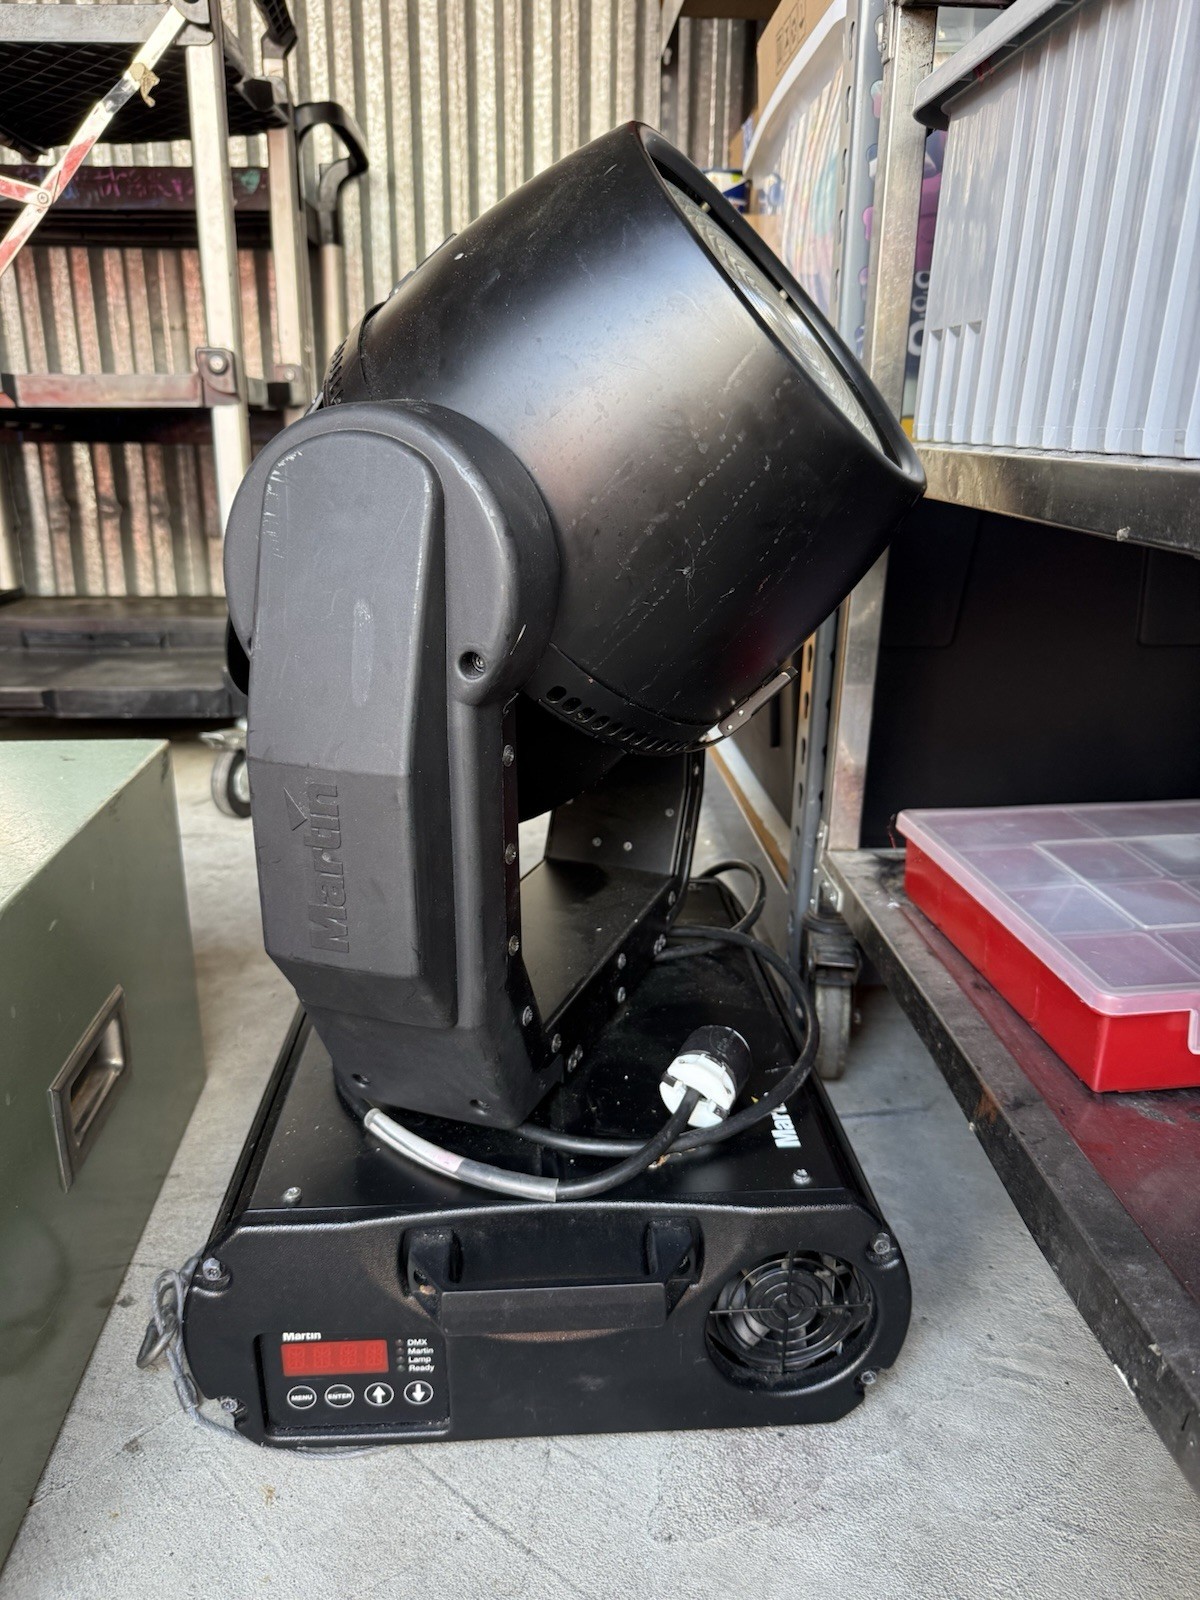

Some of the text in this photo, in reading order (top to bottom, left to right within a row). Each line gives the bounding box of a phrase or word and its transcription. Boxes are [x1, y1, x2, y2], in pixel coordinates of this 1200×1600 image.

[303, 783, 350, 953] Martin
[282, 1332, 322, 1342] Martin
[407, 1338, 428, 1346] DMX
[408, 1347, 434, 1355] Martin
[408, 1356, 432, 1364] Lamp
[409, 1364, 435, 1373] Ready
[327, 1392, 351, 1400] ENTER
